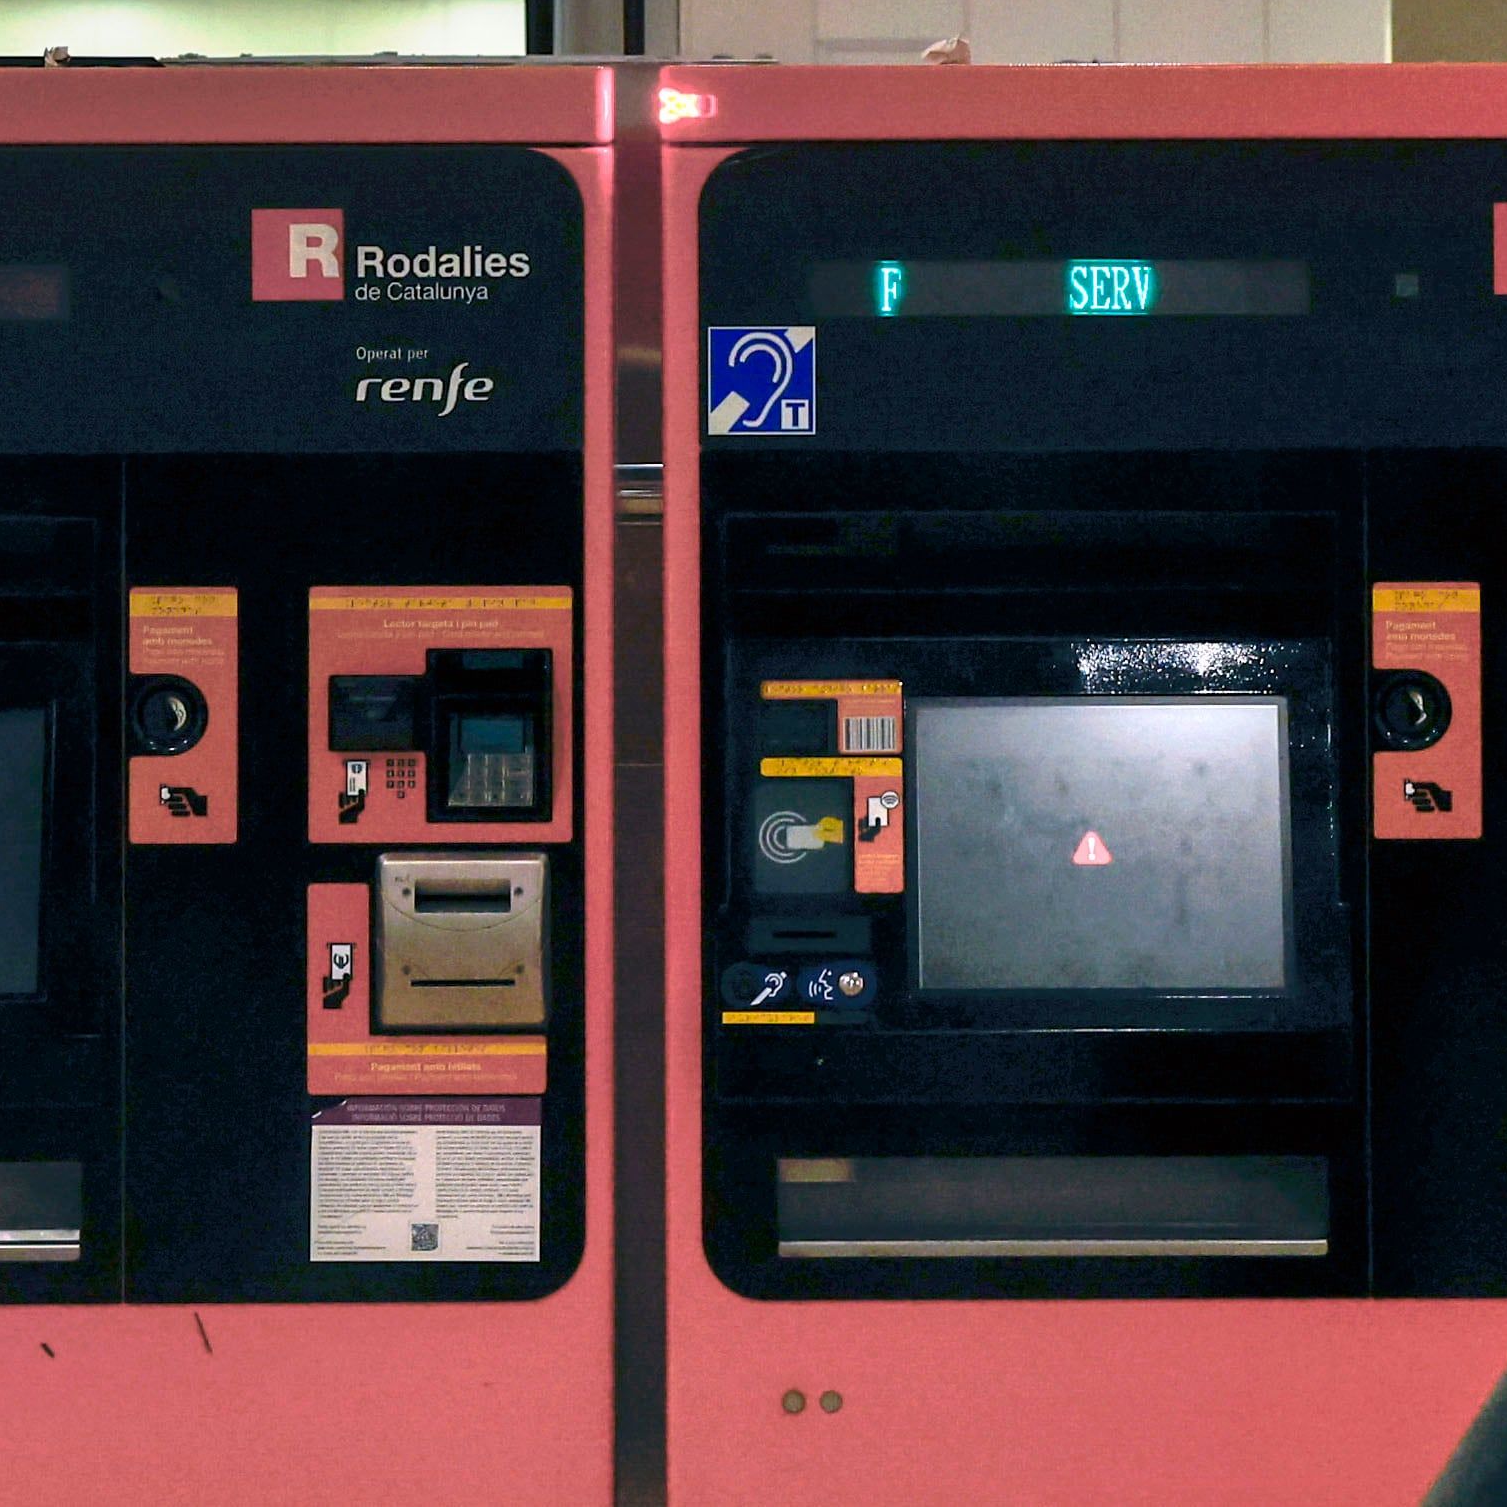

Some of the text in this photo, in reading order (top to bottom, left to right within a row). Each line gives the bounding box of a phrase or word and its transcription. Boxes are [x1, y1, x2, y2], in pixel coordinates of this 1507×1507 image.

[289, 223, 340, 278] R
[357, 245, 530, 279] Rodalies
[354, 281, 489, 305] de Catalunya
[881, 265, 1150, 315] F SERV
[355, 346, 429, 364] Operat per
[356, 362, 494, 417] renfe
